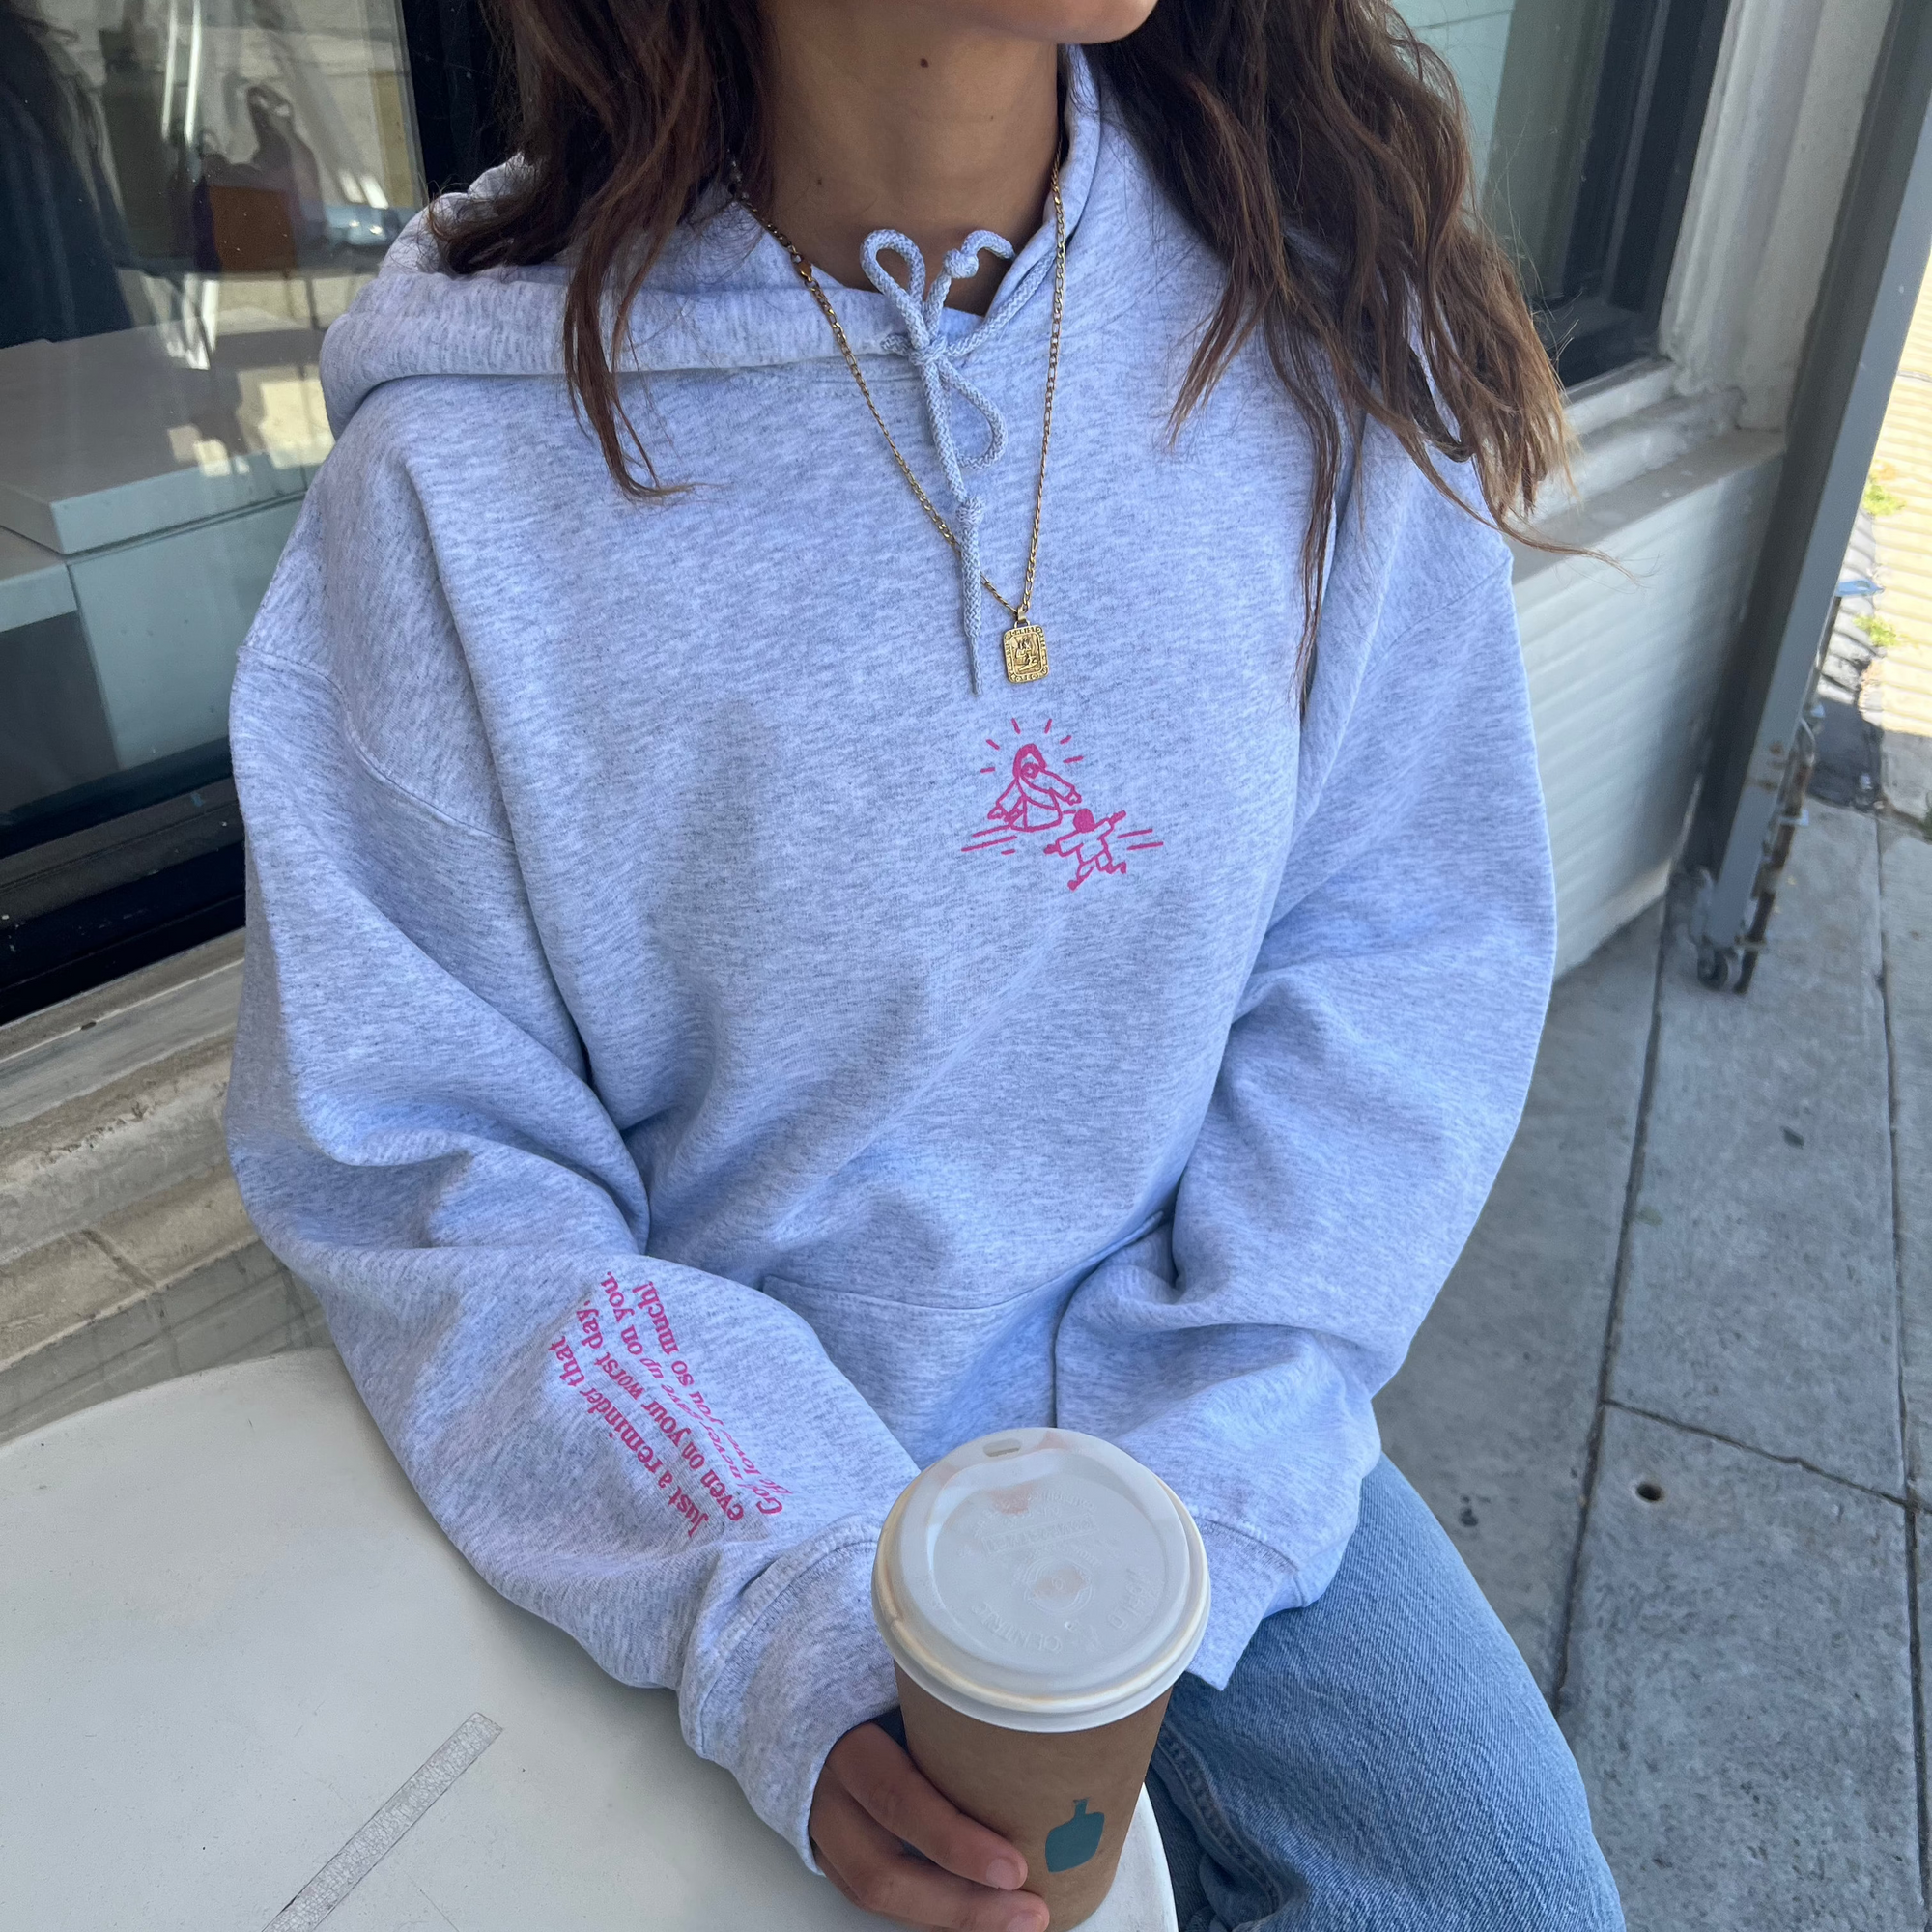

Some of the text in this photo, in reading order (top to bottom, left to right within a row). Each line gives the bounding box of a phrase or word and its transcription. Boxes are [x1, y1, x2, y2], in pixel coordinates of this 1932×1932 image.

[600, 1271, 636, 1323] you.
[631, 1280, 680, 1356] much!
[620, 1324, 643, 1355] on
[593, 1351, 645, 1401] worst
[639, 1357, 665, 1379] up
[670, 1360, 695, 1387] so
[640, 1400, 691, 1448] your
[689, 1390, 724, 1426] you
[548, 1335, 709, 1538] Just a reminder that
[681, 1441, 705, 1470] on
[699, 1421, 744, 1481] never
[701, 1469, 744, 1521] even
